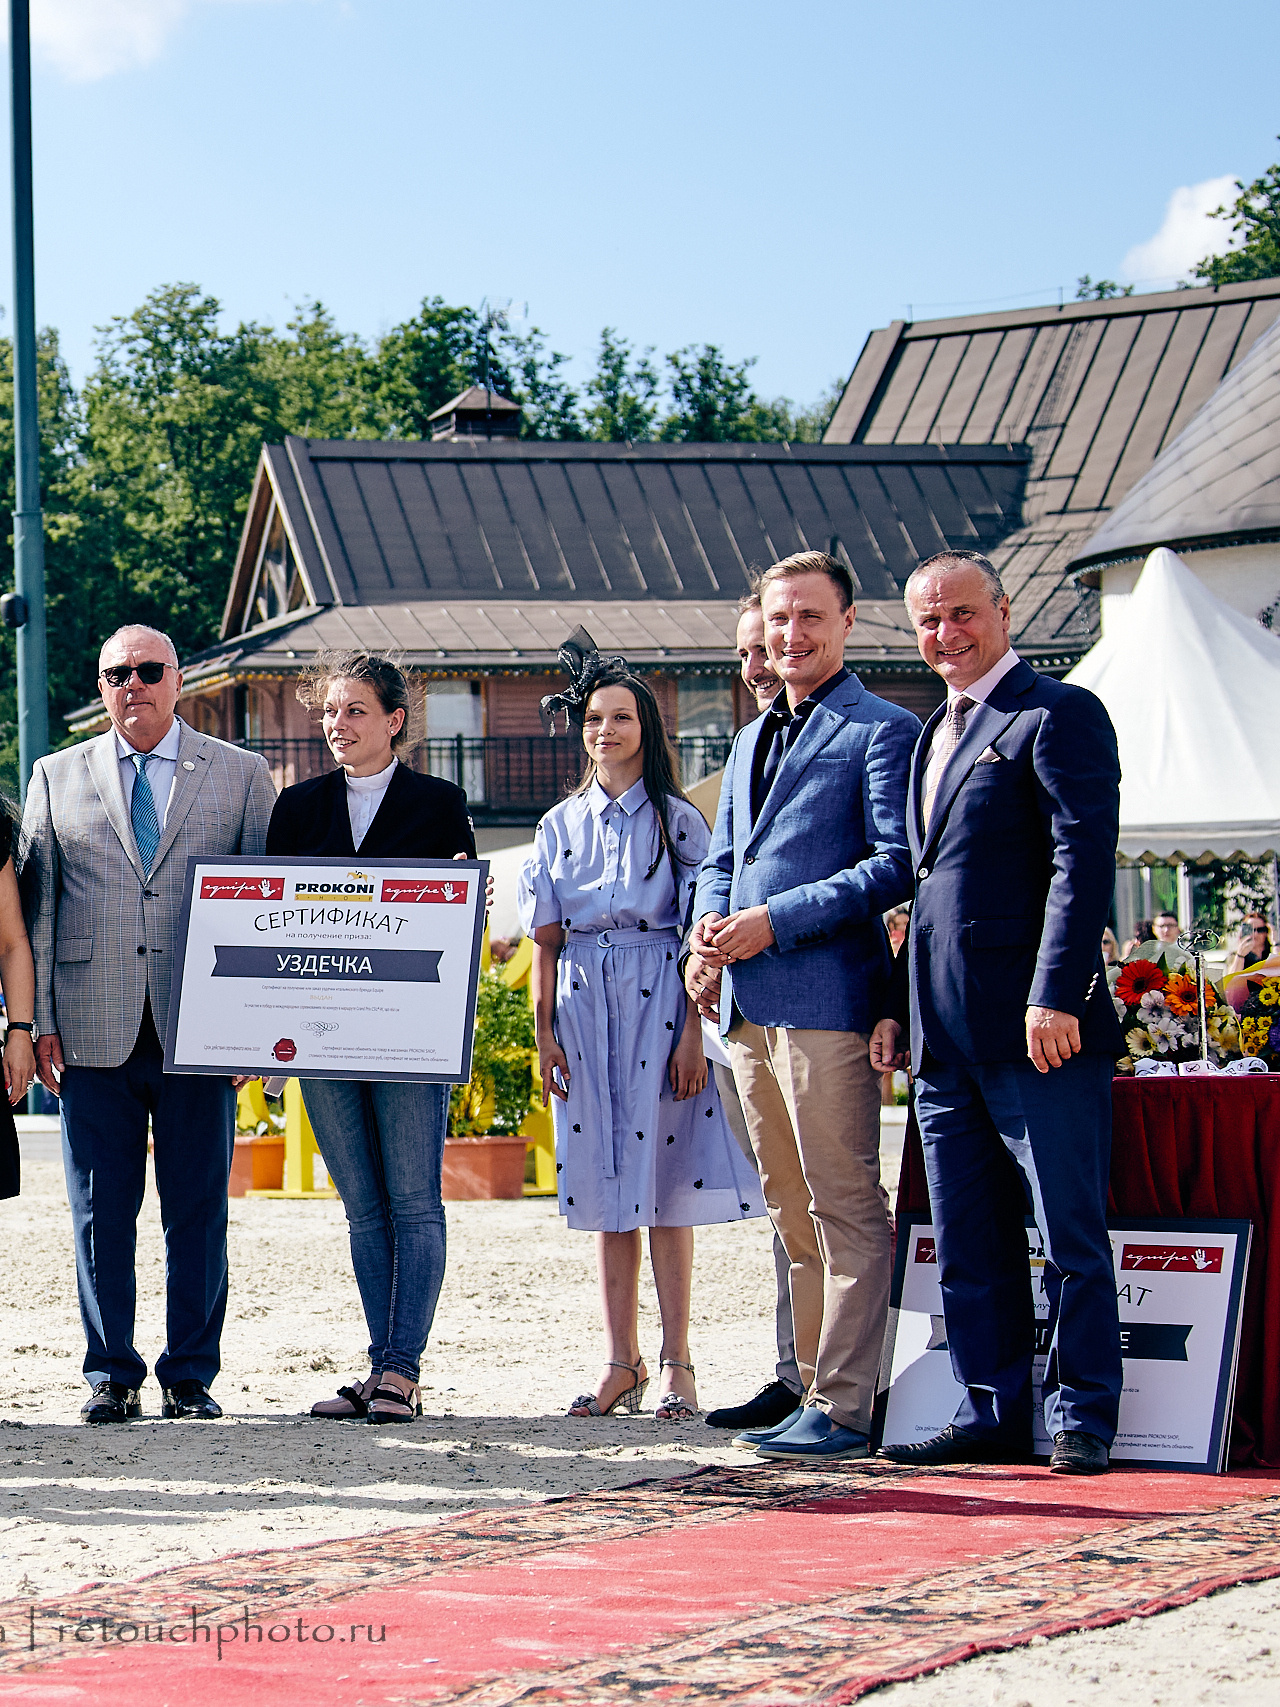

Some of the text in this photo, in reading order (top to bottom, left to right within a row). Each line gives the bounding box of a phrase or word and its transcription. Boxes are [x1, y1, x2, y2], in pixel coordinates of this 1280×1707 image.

[203, 881, 257, 898] equipe
[295, 883, 375, 894] PROKONI
[384, 884, 439, 902] equipe
[253, 907, 409, 935] СЕРТИФИКАТ
[276, 953, 374, 977] УЗДЕЧКА
[1125, 1251, 1189, 1270] equipe
